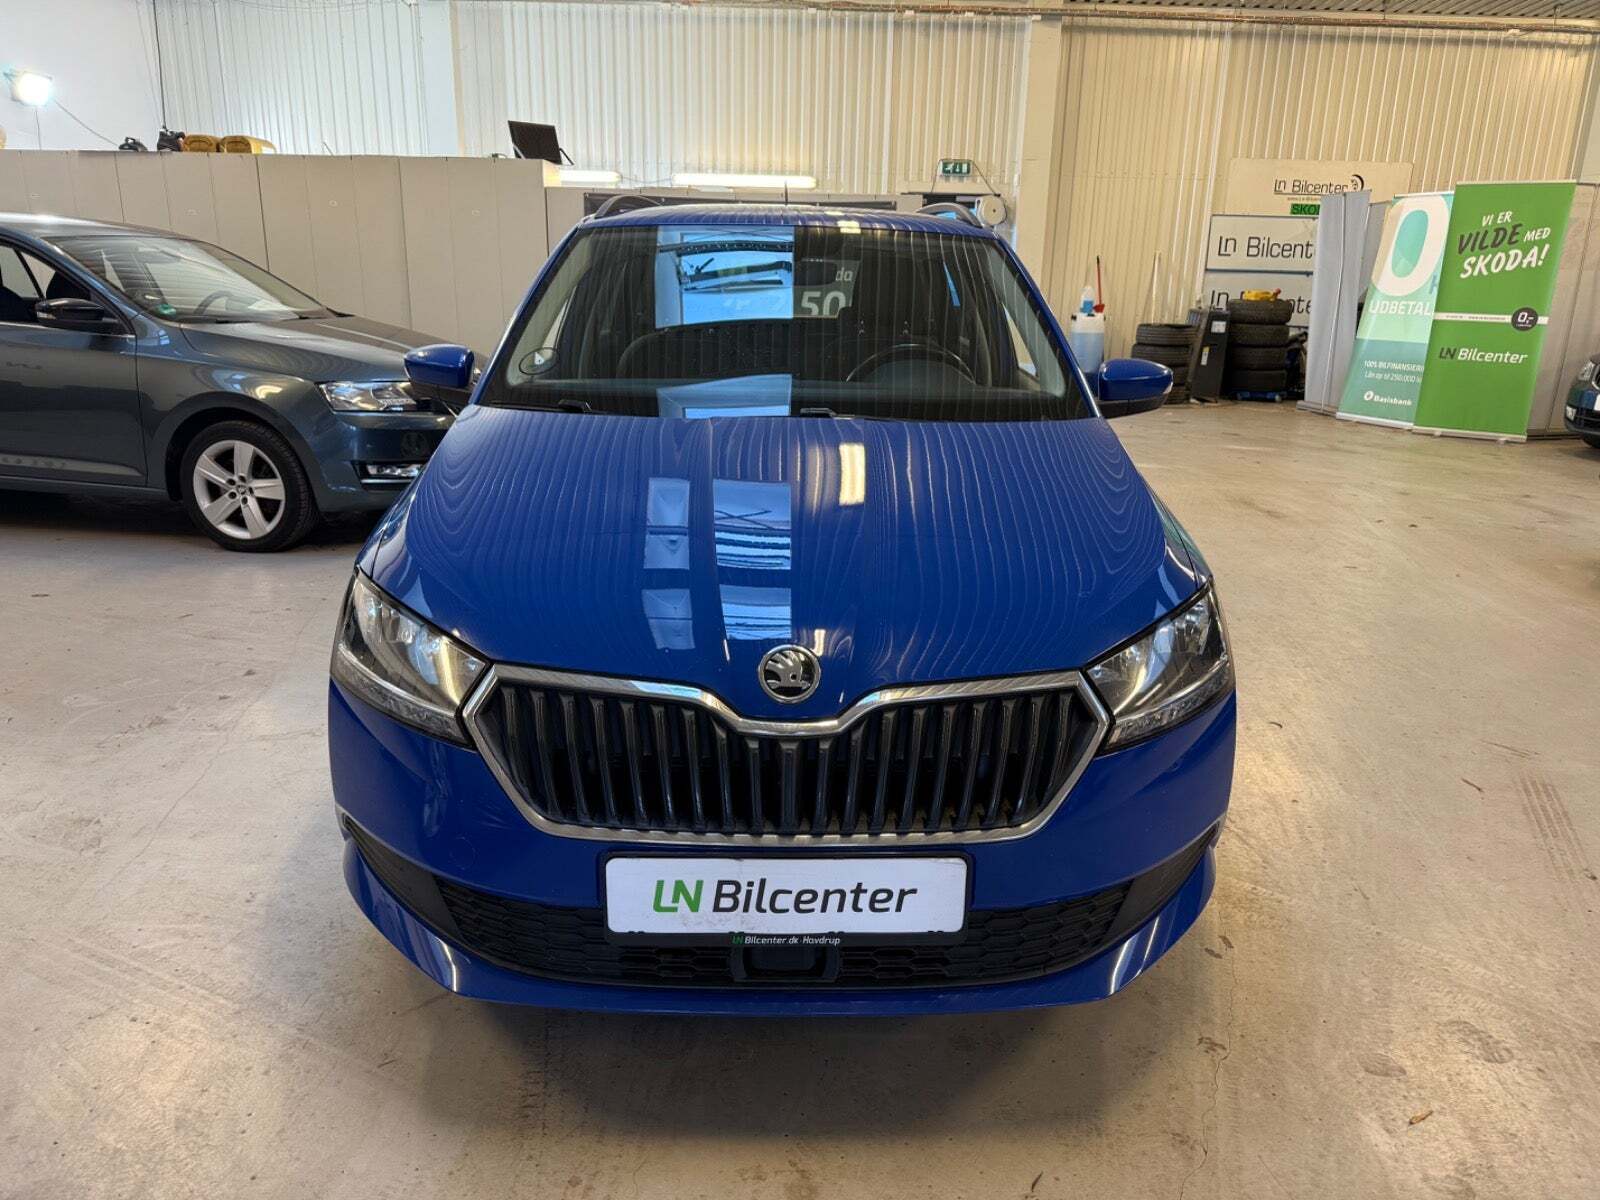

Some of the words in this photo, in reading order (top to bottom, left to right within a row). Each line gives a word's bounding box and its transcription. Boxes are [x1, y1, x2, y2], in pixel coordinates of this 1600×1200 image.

[1292, 179, 1349, 194] Bilcenter
[1291, 203, 1320, 215] SKO
[1482, 214, 1494, 227] VI
[1497, 211, 1513, 224] ER
[1458, 223, 1523, 254] VILDE
[1523, 227, 1551, 242] MED
[1460, 243, 1550, 278] SKODA!
[1439, 347, 1457, 359] LN
[1458, 348, 1528, 364] Bilcenter
[652, 879, 704, 913] LN
[713, 878, 918, 914] Bilcenter
